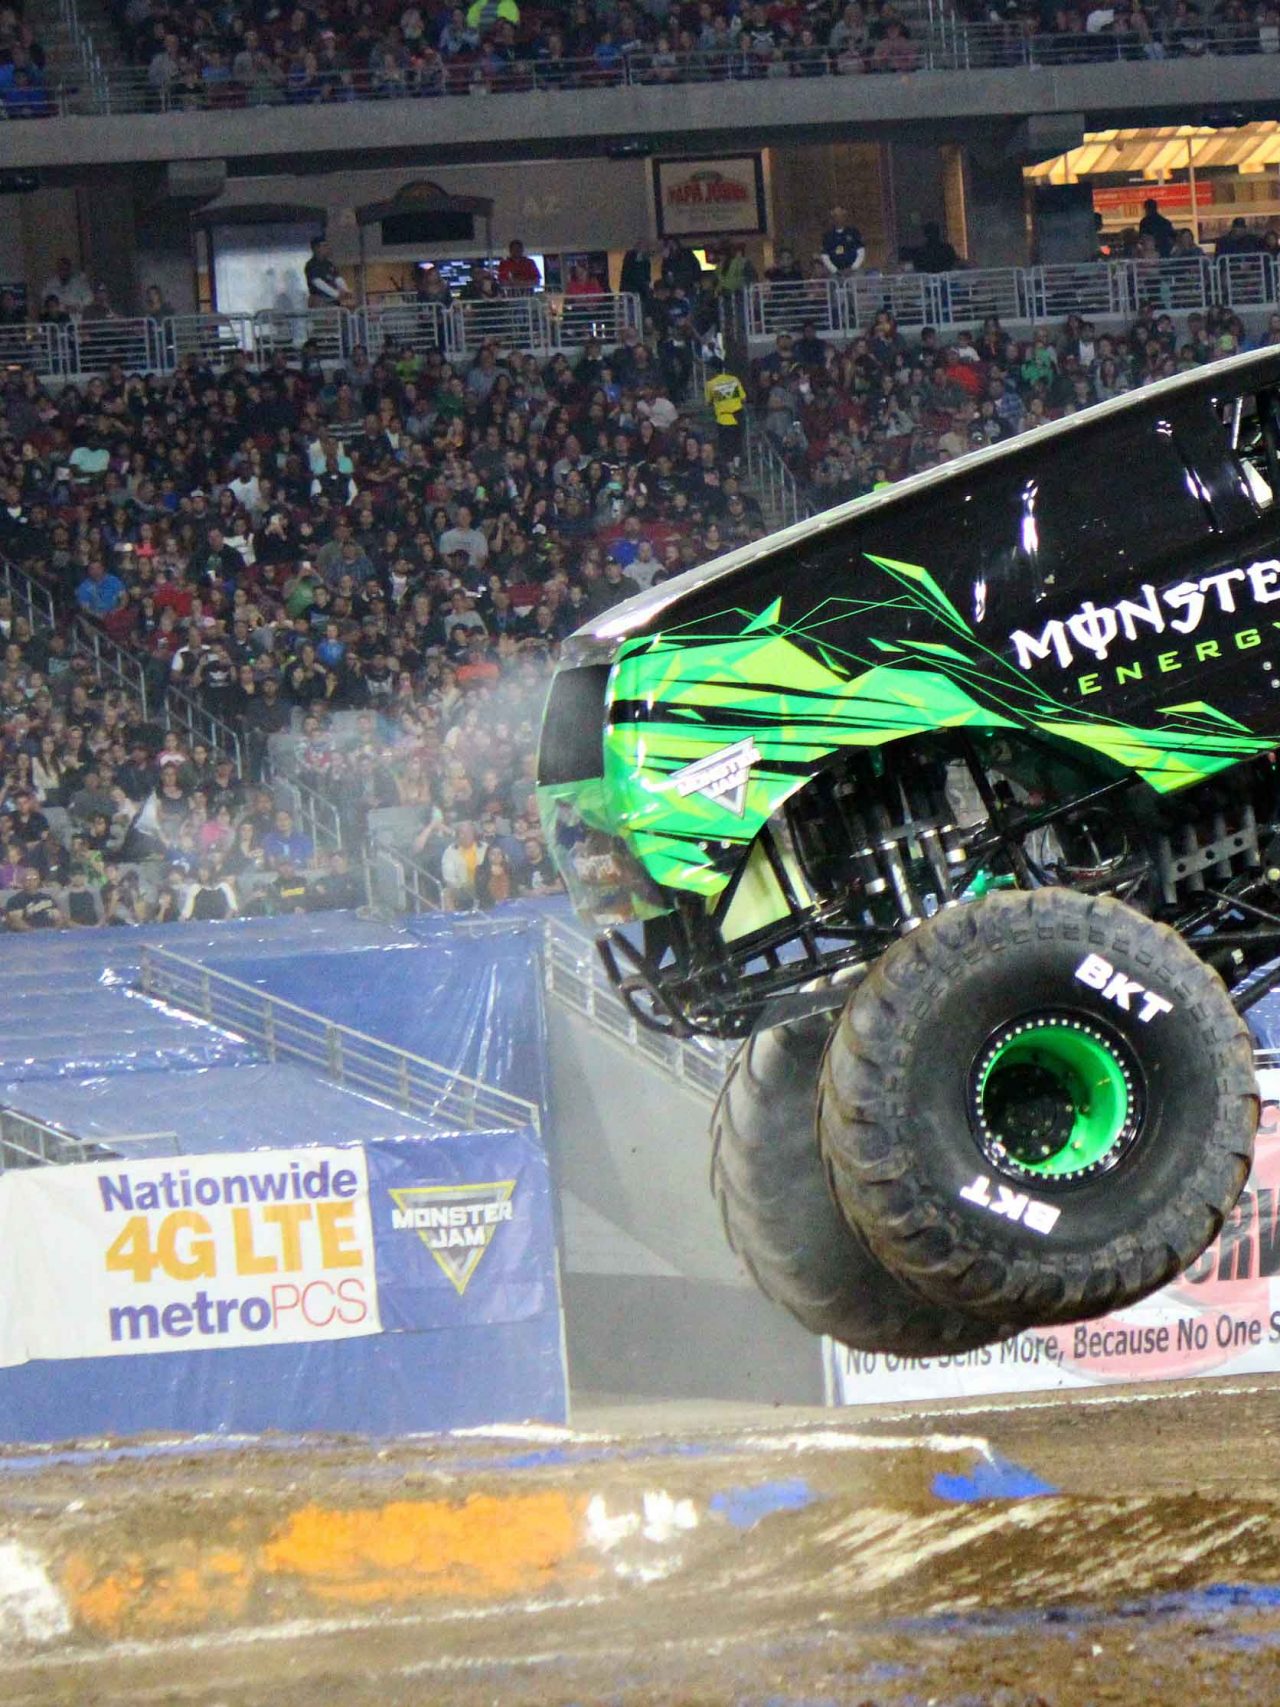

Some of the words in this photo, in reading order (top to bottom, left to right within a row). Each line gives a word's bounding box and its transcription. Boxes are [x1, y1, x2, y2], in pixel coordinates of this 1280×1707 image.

[1075, 953, 1174, 1023] BKT
[97, 1161, 358, 1213] Nationwide
[392, 1202, 513, 1230] MONSTER
[959, 1174, 1061, 1235] BKT
[105, 1209, 217, 1283] 4G
[232, 1200, 364, 1277] LTE
[430, 1222, 486, 1249] JAM
[109, 1278, 367, 1341] metroPCS
[846, 1350, 876, 1376] No
[1000, 1330, 1064, 1367] More,
[1074, 1324, 1170, 1360] Because
[1177, 1318, 1208, 1351] No
[1215, 1314, 1262, 1347] One
